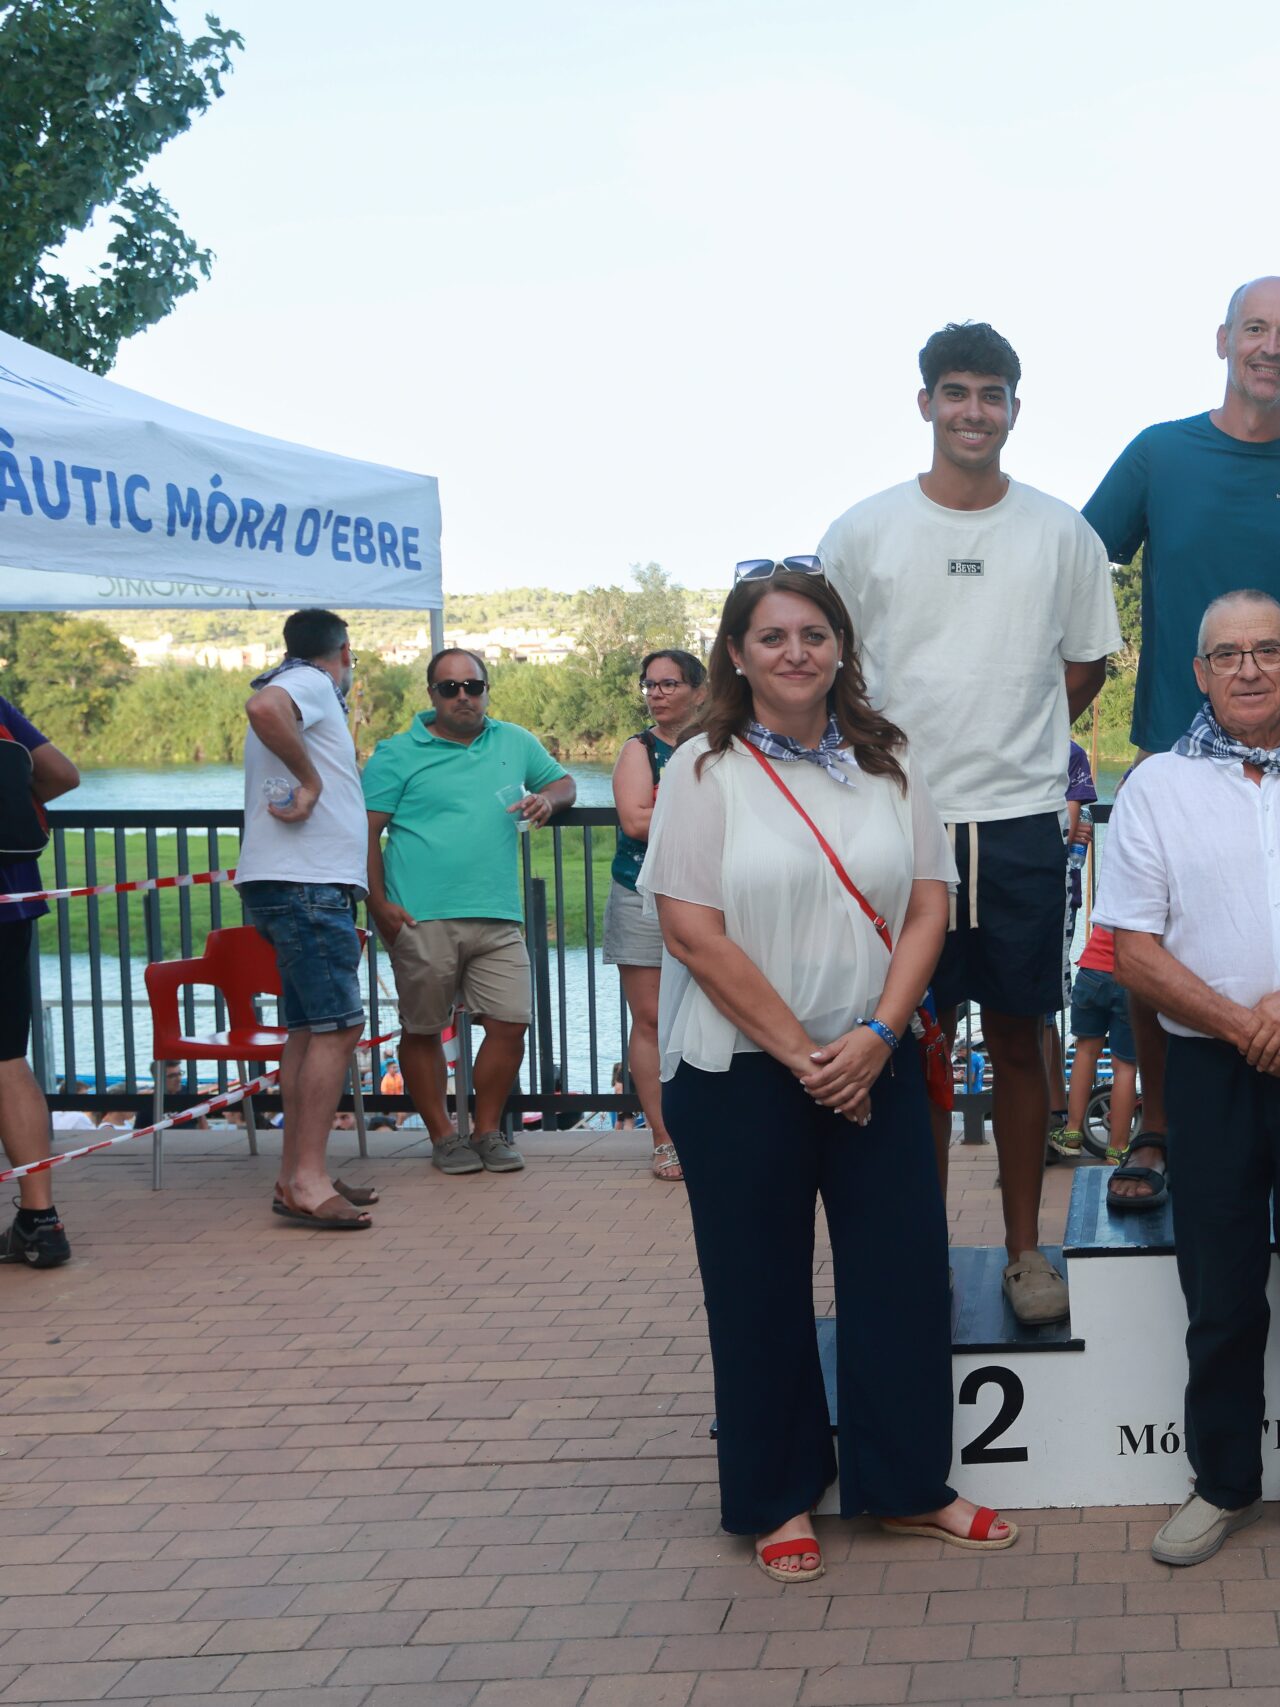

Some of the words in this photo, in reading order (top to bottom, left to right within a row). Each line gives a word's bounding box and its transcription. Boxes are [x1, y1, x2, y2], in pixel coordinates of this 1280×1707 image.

[0, 427, 153, 533] ÀUTIC
[294, 508, 422, 571] D'EBRE
[958, 1365, 1029, 1465] 2
[1116, 1422, 1188, 1456] Mó
